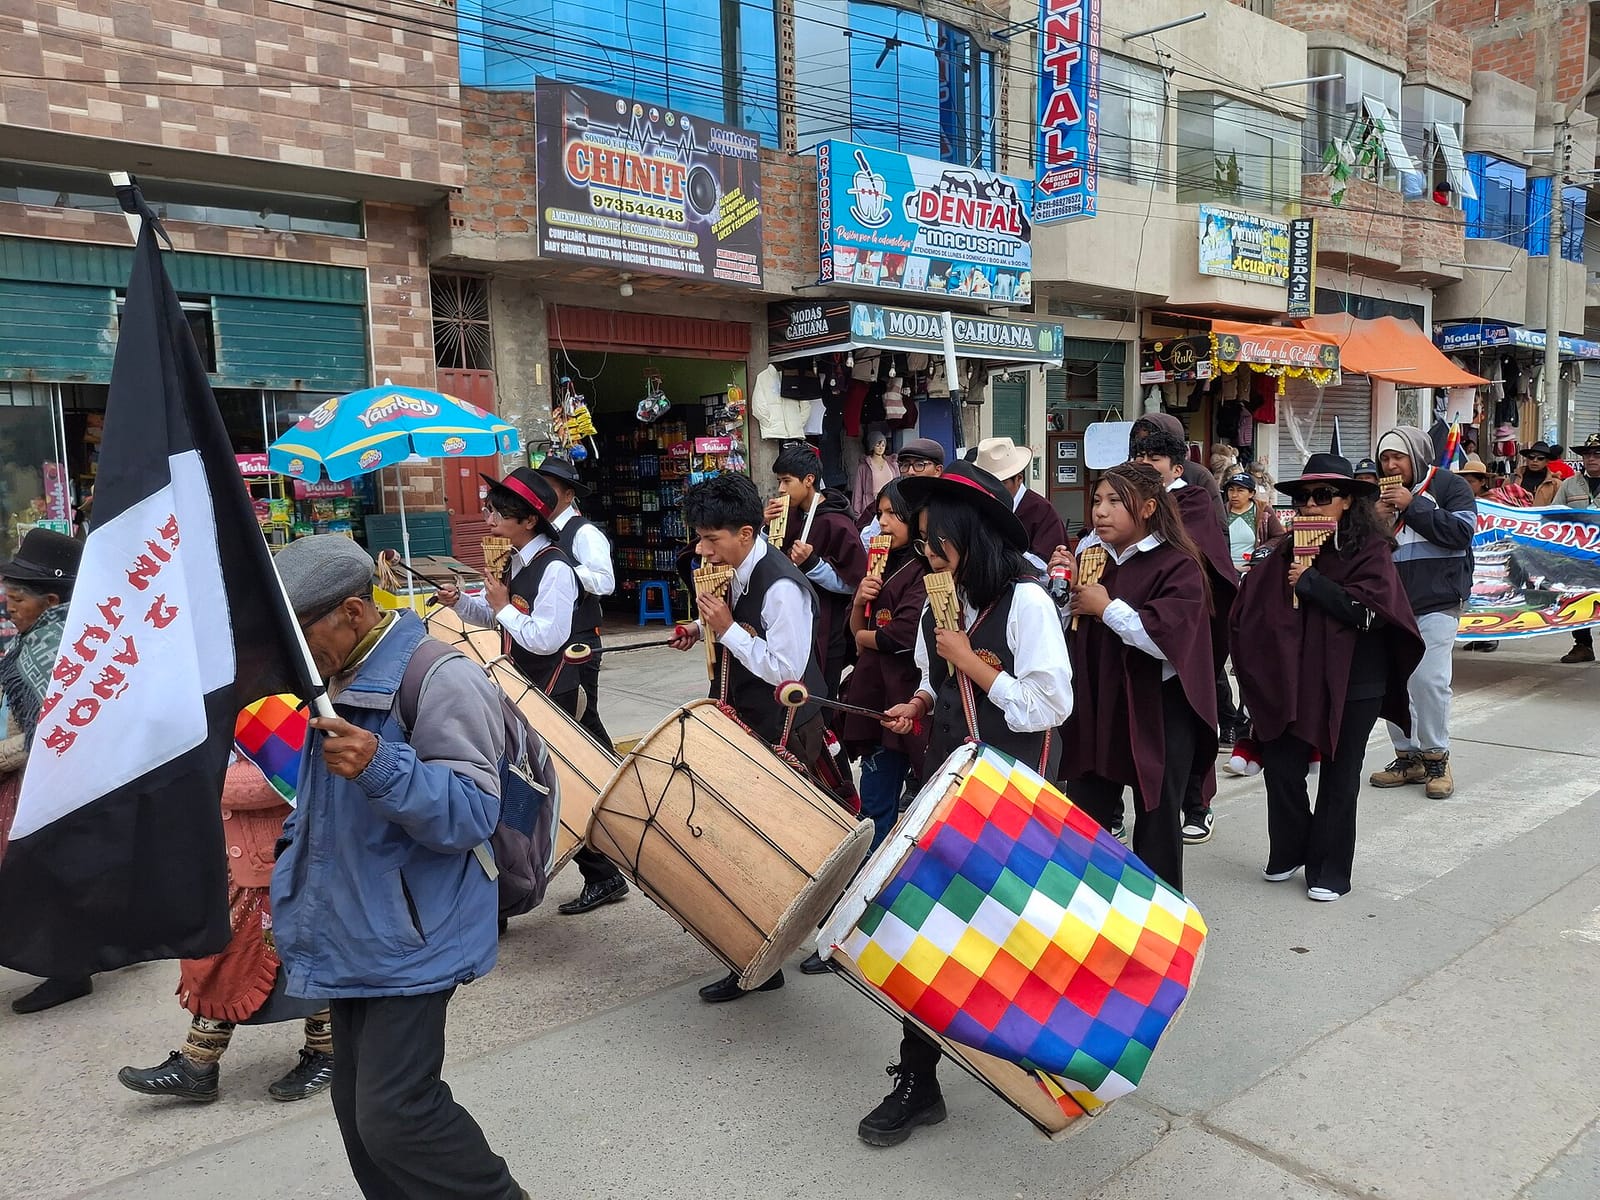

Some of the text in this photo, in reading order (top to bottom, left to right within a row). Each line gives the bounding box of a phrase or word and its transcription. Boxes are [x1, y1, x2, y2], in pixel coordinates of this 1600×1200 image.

[584, 133, 611, 146] SONIDO
[618, 141, 640, 153] LUCES
[654, 148, 677, 160] ACTIVO
[1045, 170, 1079, 184] SEGUNDO
[1053, 179, 1070, 188] PISO
[592, 193, 685, 223] 973544443
[819, 144, 832, 280] ORTODONCIA RX
[918, 190, 1021, 235] DENTAL
[593, 217, 609, 229] TODO
[630, 223, 670, 240] COMPROMISOS
[670, 231, 695, 243] SOCIALES
[914, 246, 941, 257] ATENDEMOS
[947, 251, 961, 259] LUNES
[965, 254, 986, 263] DOMINGO
[1292, 221, 1310, 301] HOSPEDAJE
[1232, 255, 1290, 279] Acuaris
[790, 306, 822, 324] MODAS
[786, 319, 829, 341] CAHUANA
[889, 312, 1034, 348] MODA CAHUANA
[1444, 333, 1482, 344] Modas
[238, 461, 269, 473] Trulu
[1475, 514, 1600, 551] MPESIN
[125, 513, 181, 591] SIN
[42, 634, 141, 758] AÑOS
